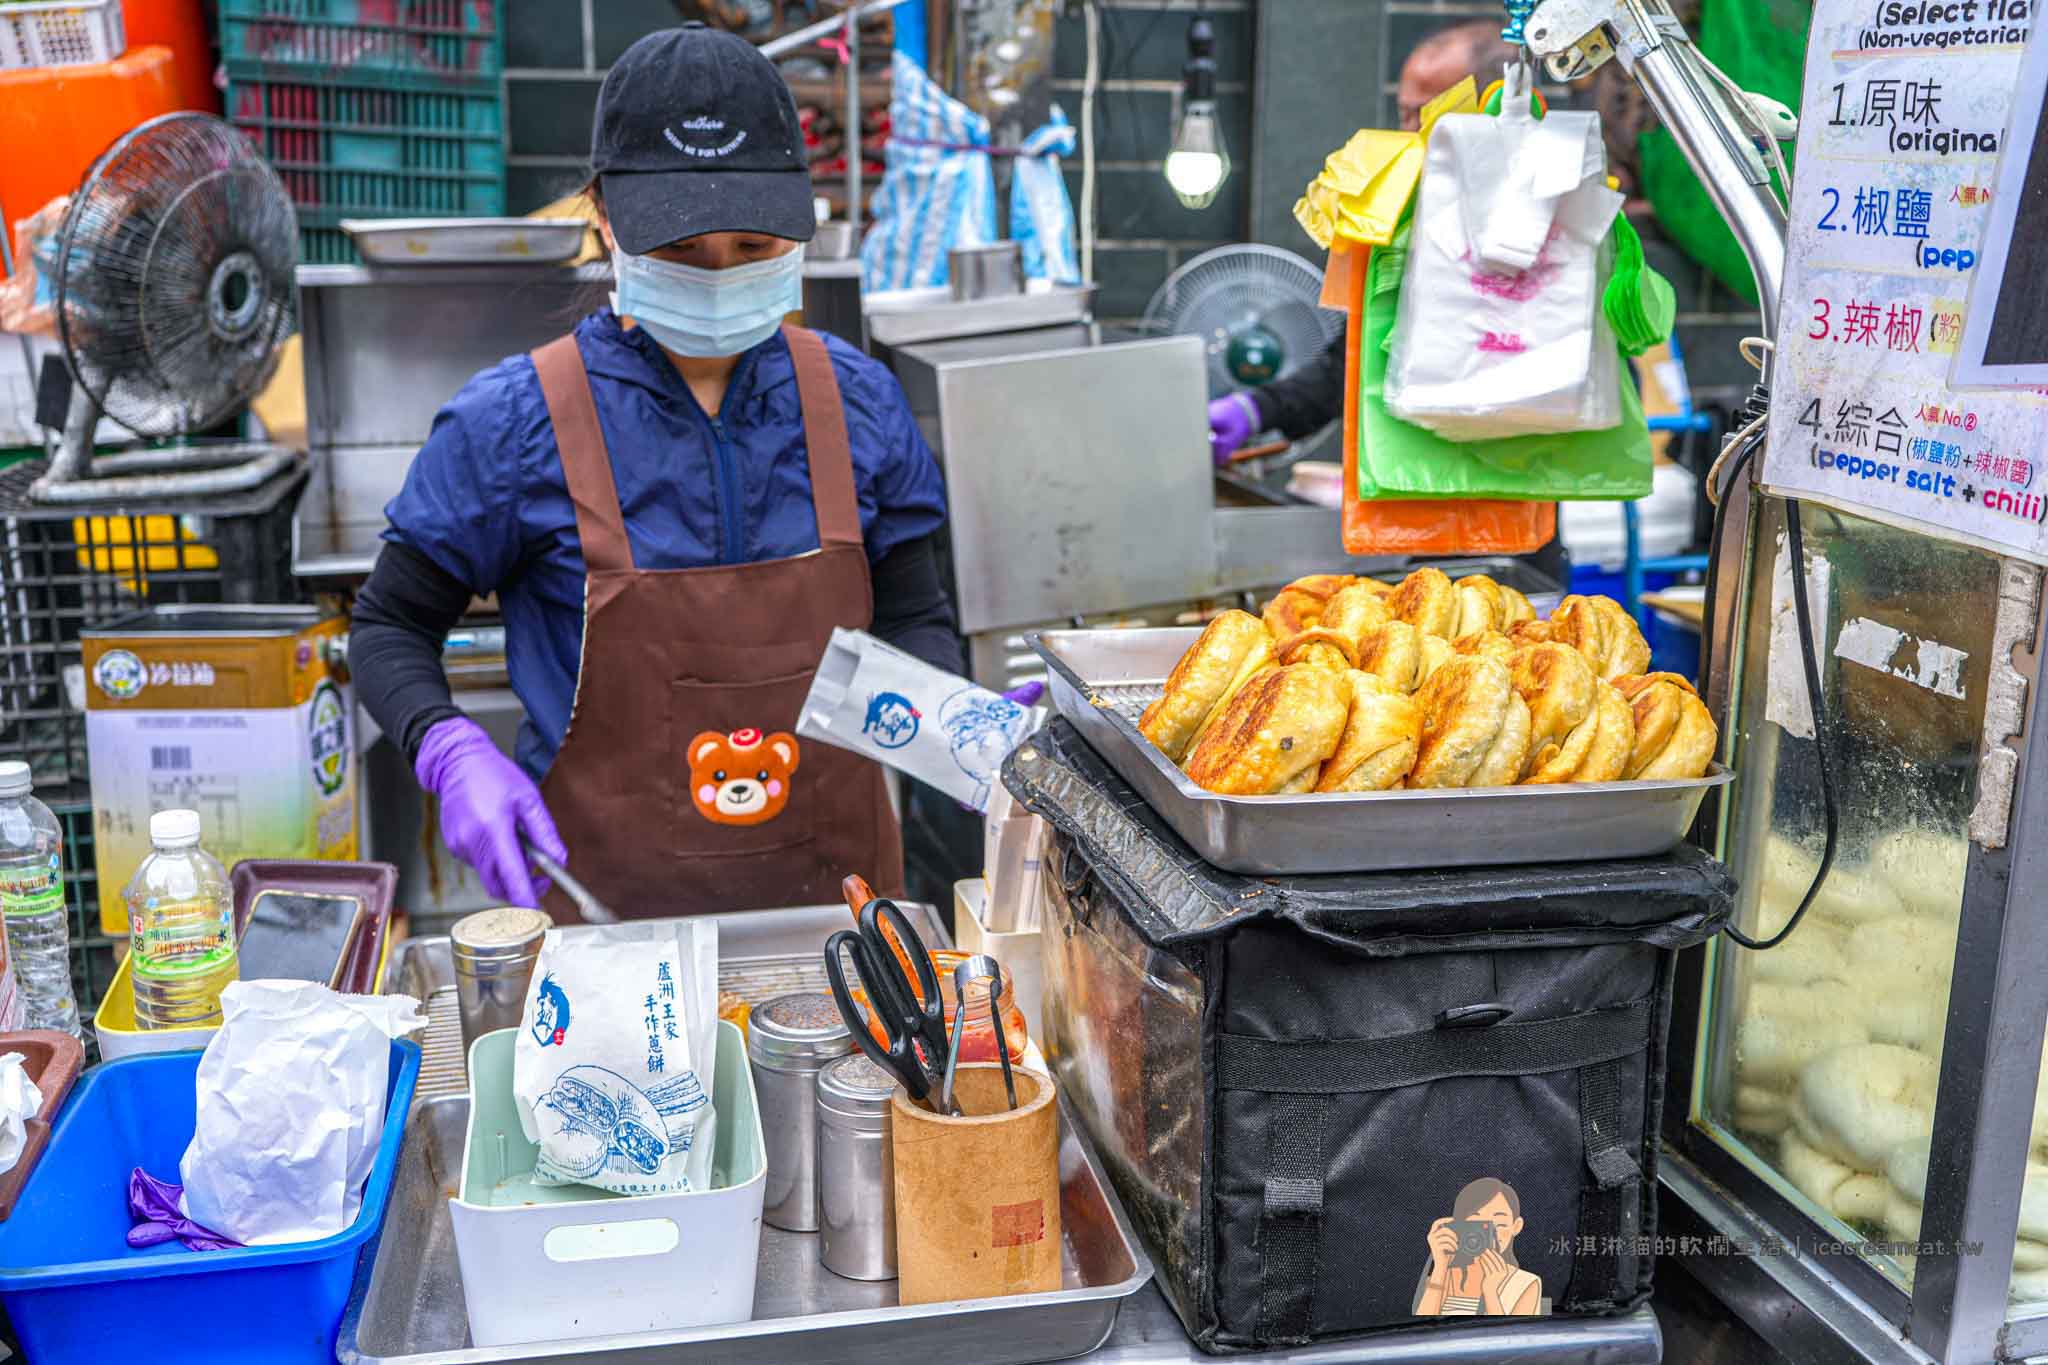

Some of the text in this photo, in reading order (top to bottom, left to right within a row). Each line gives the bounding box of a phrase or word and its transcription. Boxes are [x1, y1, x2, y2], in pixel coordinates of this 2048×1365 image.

[1828, 77, 1942, 127] 1.原味
[1816, 185, 1934, 239] 2.椒鹽
[1808, 298, 1923, 354] 3.辣椒
[1798, 398, 1909, 457] 4.綜合
[1811, 441, 1901, 483] (pepper
[1905, 469, 1957, 498] salt
